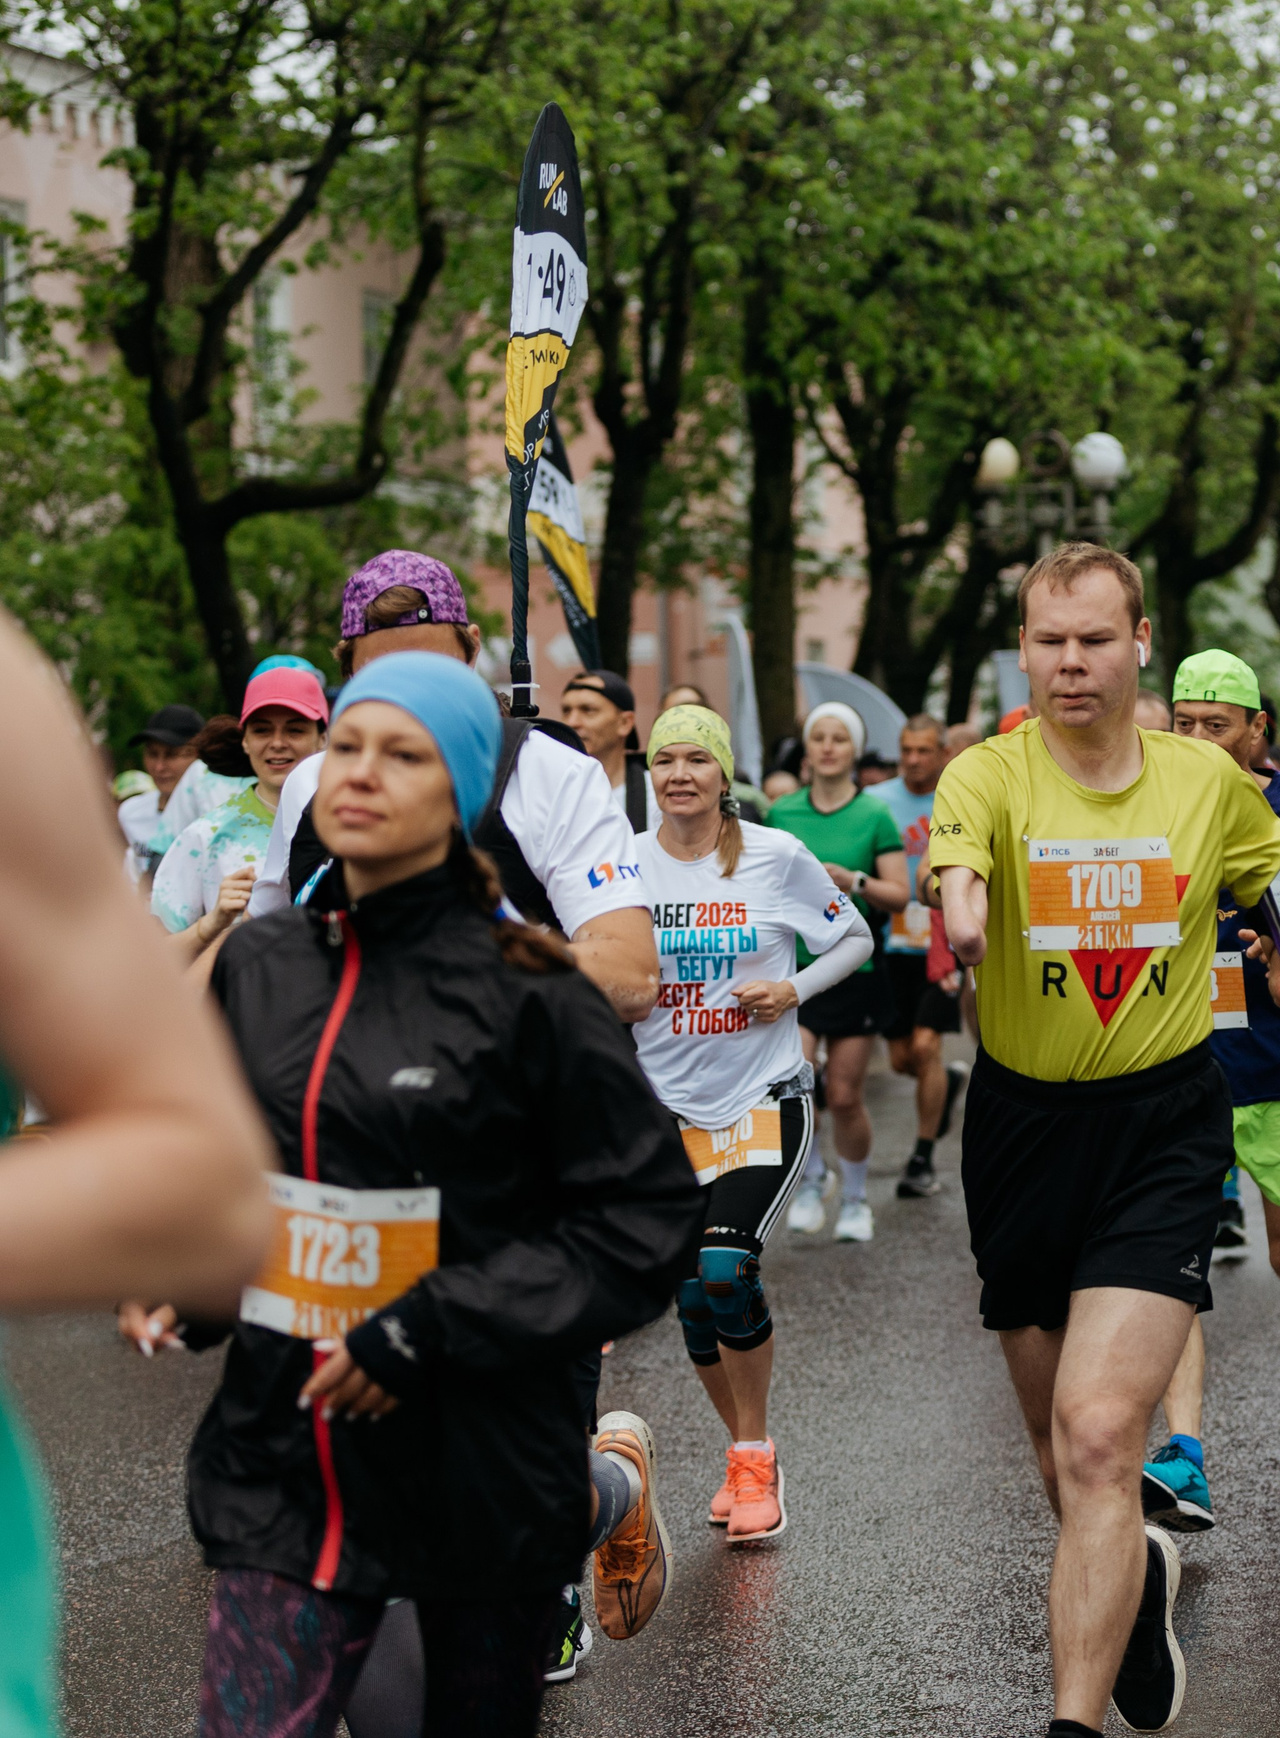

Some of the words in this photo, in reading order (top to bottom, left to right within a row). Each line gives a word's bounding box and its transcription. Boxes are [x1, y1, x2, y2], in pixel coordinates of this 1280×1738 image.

[539, 163, 557, 190] RUN
[552, 187, 568, 217] LAB
[1051, 848, 1070, 856] ПСБ
[1067, 862, 1142, 909] 1709
[661, 926, 757, 956] ПЛАНЕТЫ
[676, 955, 737, 982] БЕГУТ
[1041, 960, 1169, 1000] RUN
[672, 1009, 683, 1036] С
[287, 1214, 380, 1288] 1723
